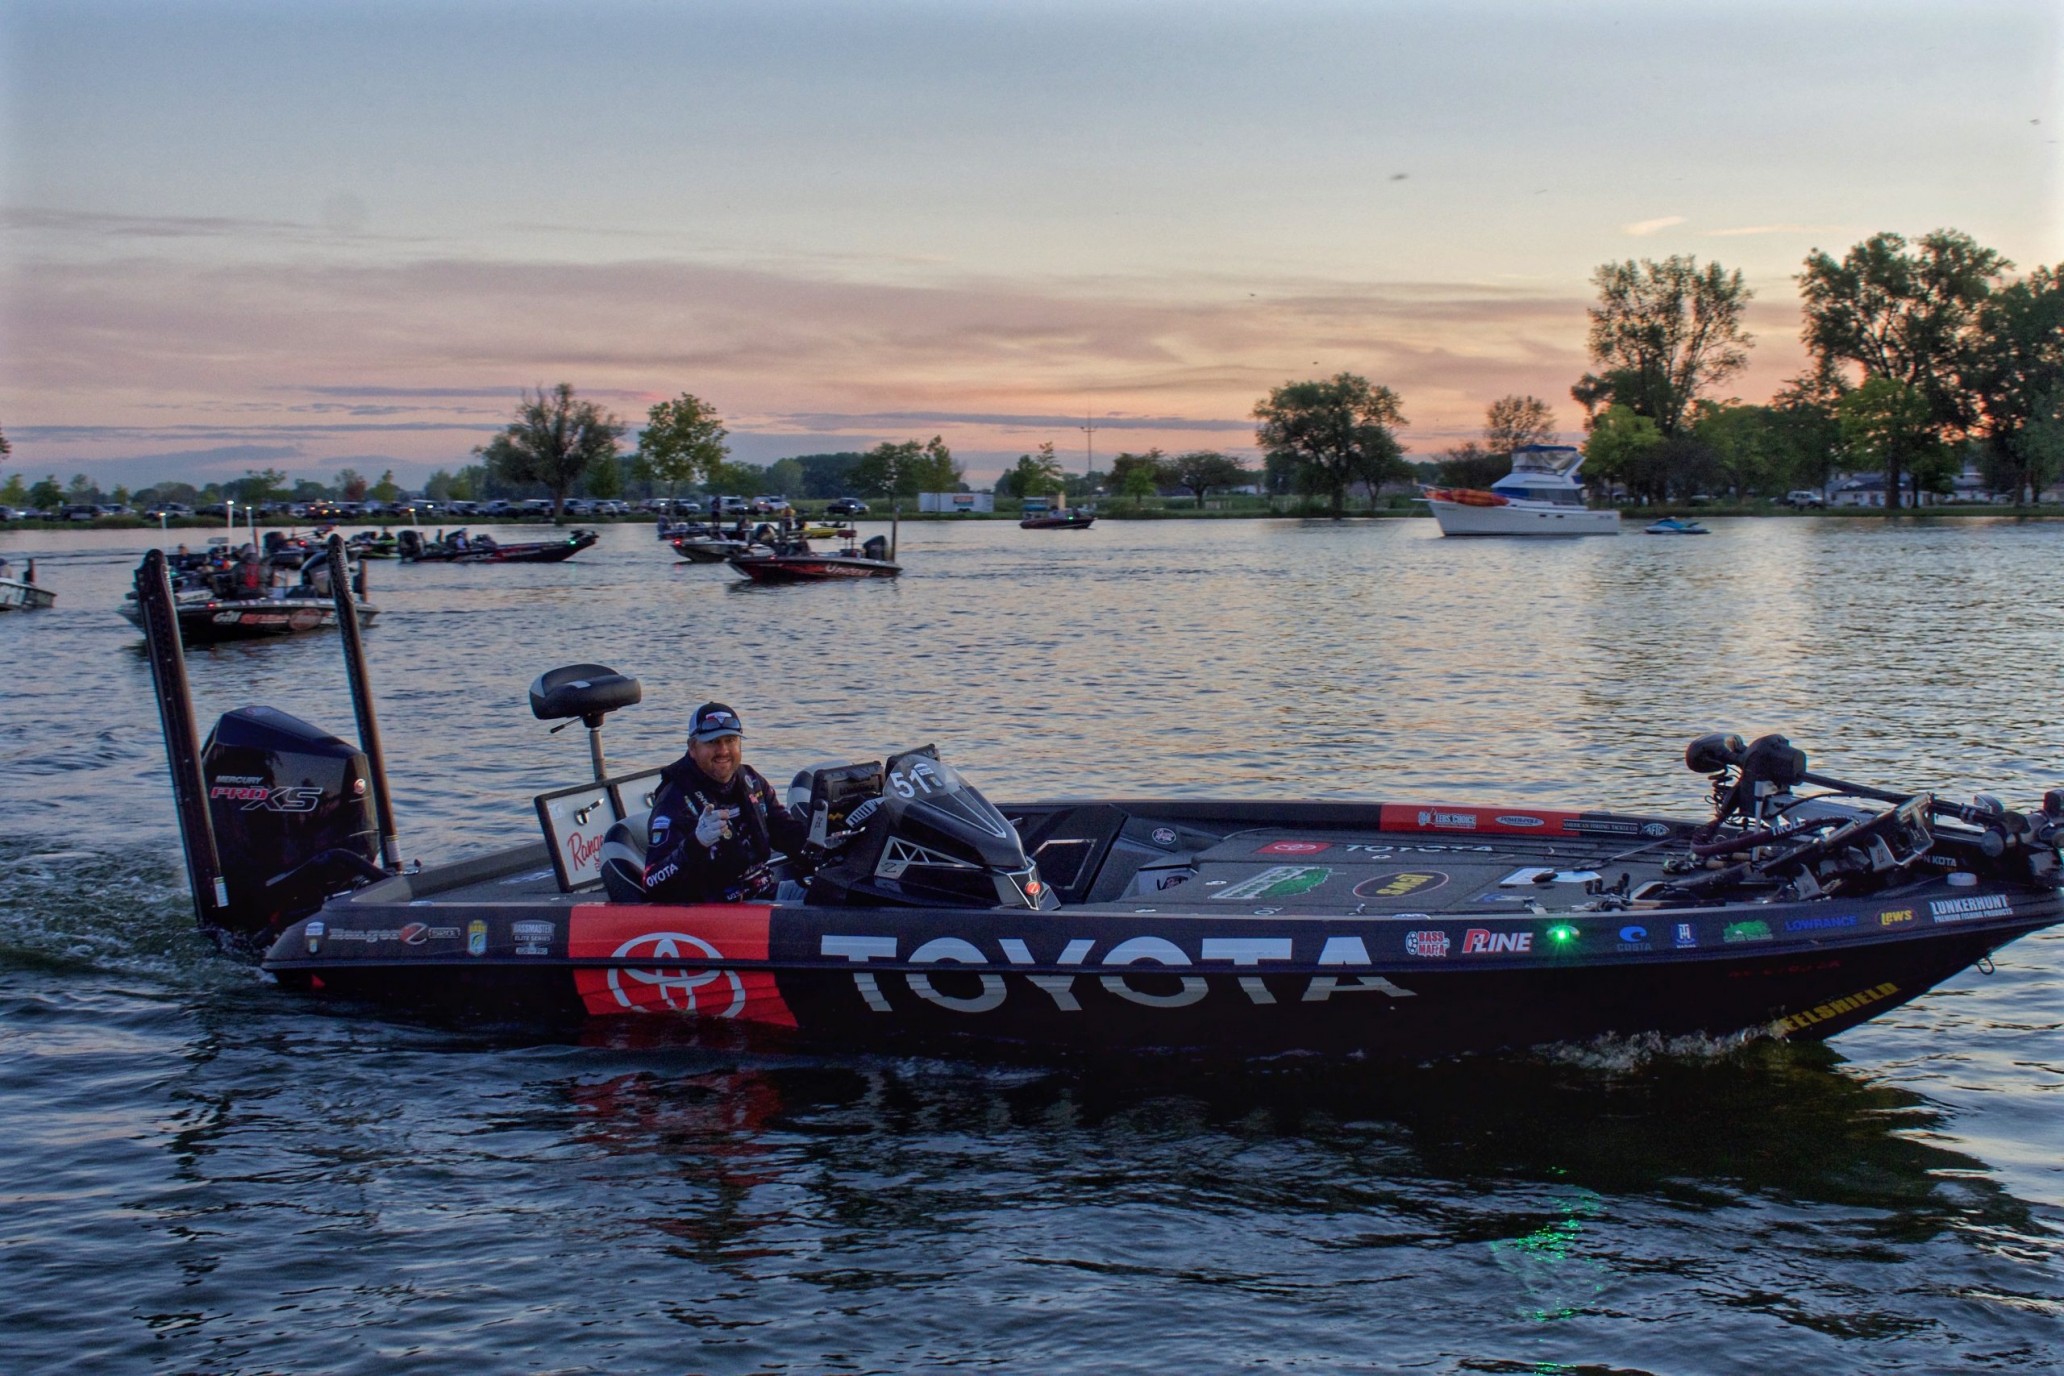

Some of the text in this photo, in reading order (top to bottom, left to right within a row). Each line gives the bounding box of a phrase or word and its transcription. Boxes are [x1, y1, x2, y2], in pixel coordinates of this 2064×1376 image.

[215, 775, 264, 785] MERCURY
[890, 768, 931, 798] 51
[1346, 844, 1493, 852] TOYOTA
[1931, 854, 1957, 867] KOTA
[646, 863, 679, 887] OYOTA
[1929, 894, 2008, 915] LUNKERHUNT
[513, 924, 553, 934] BASSMASTER
[1784, 914, 1857, 932] LOWRANCE
[1418, 931, 1444, 943] BASS
[1418, 943, 1446, 957] MAFIA
[1616, 943, 1654, 952] COSTA
[821, 935, 1417, 1013] TOYOTA
[1778, 981, 1902, 1034] EELSHIELD
